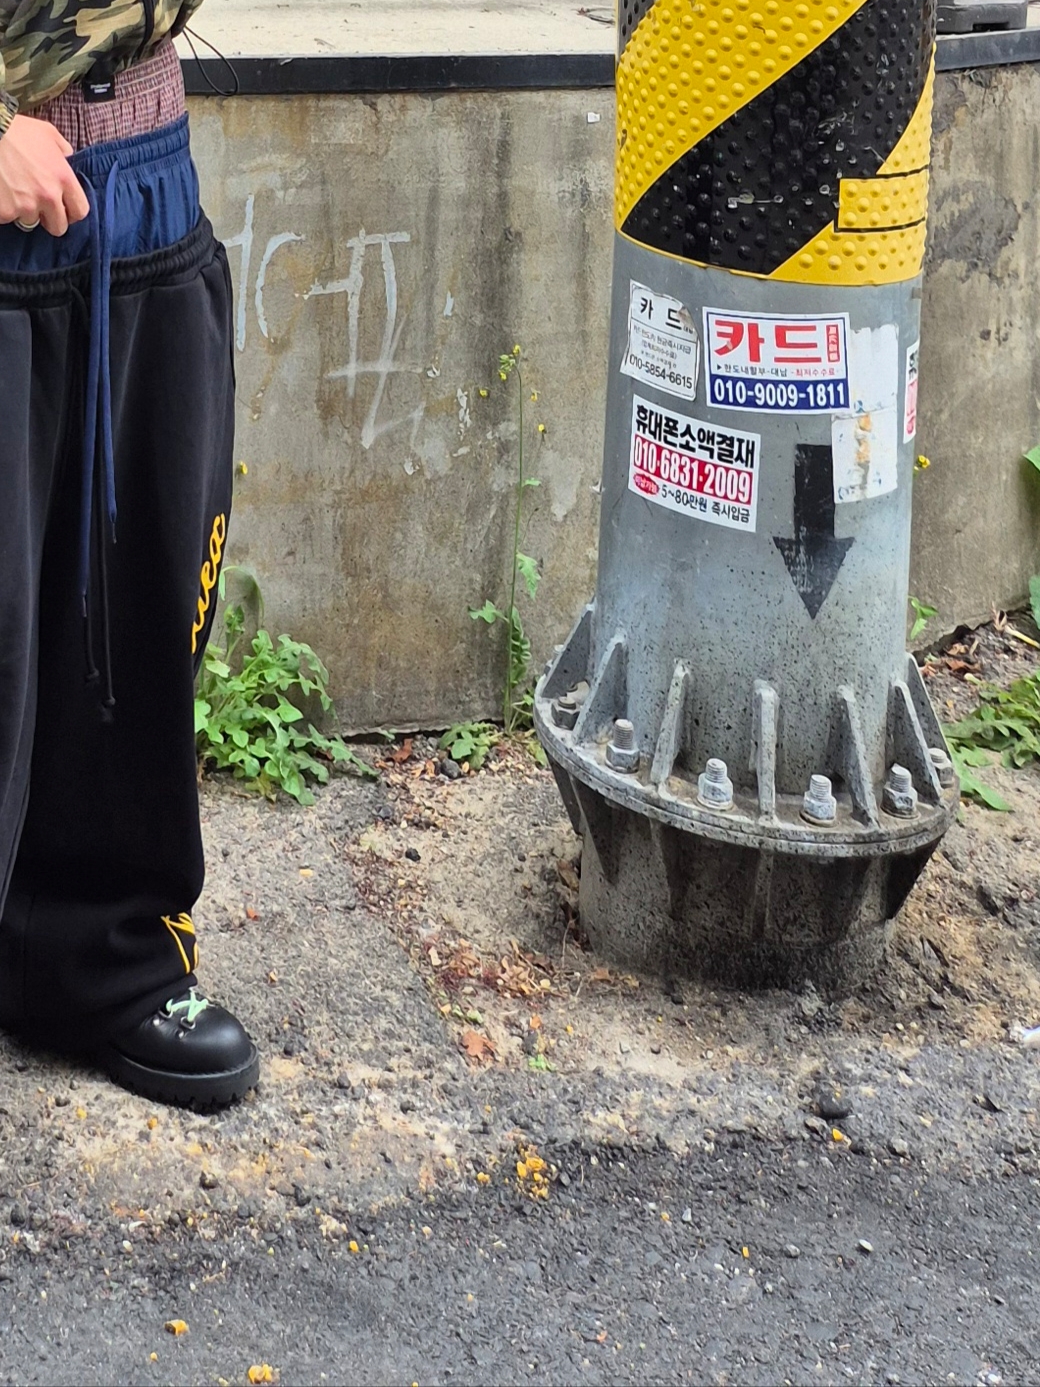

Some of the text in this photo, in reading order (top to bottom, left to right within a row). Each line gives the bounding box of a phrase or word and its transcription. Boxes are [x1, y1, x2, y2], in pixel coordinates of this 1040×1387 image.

[714, 319, 822, 363] 카드
[629, 353, 693, 390] 010-5854-6615
[713, 378, 846, 408] 010-9009-1811
[661, 483, 751, 524] 5~80만원 즉시입금
